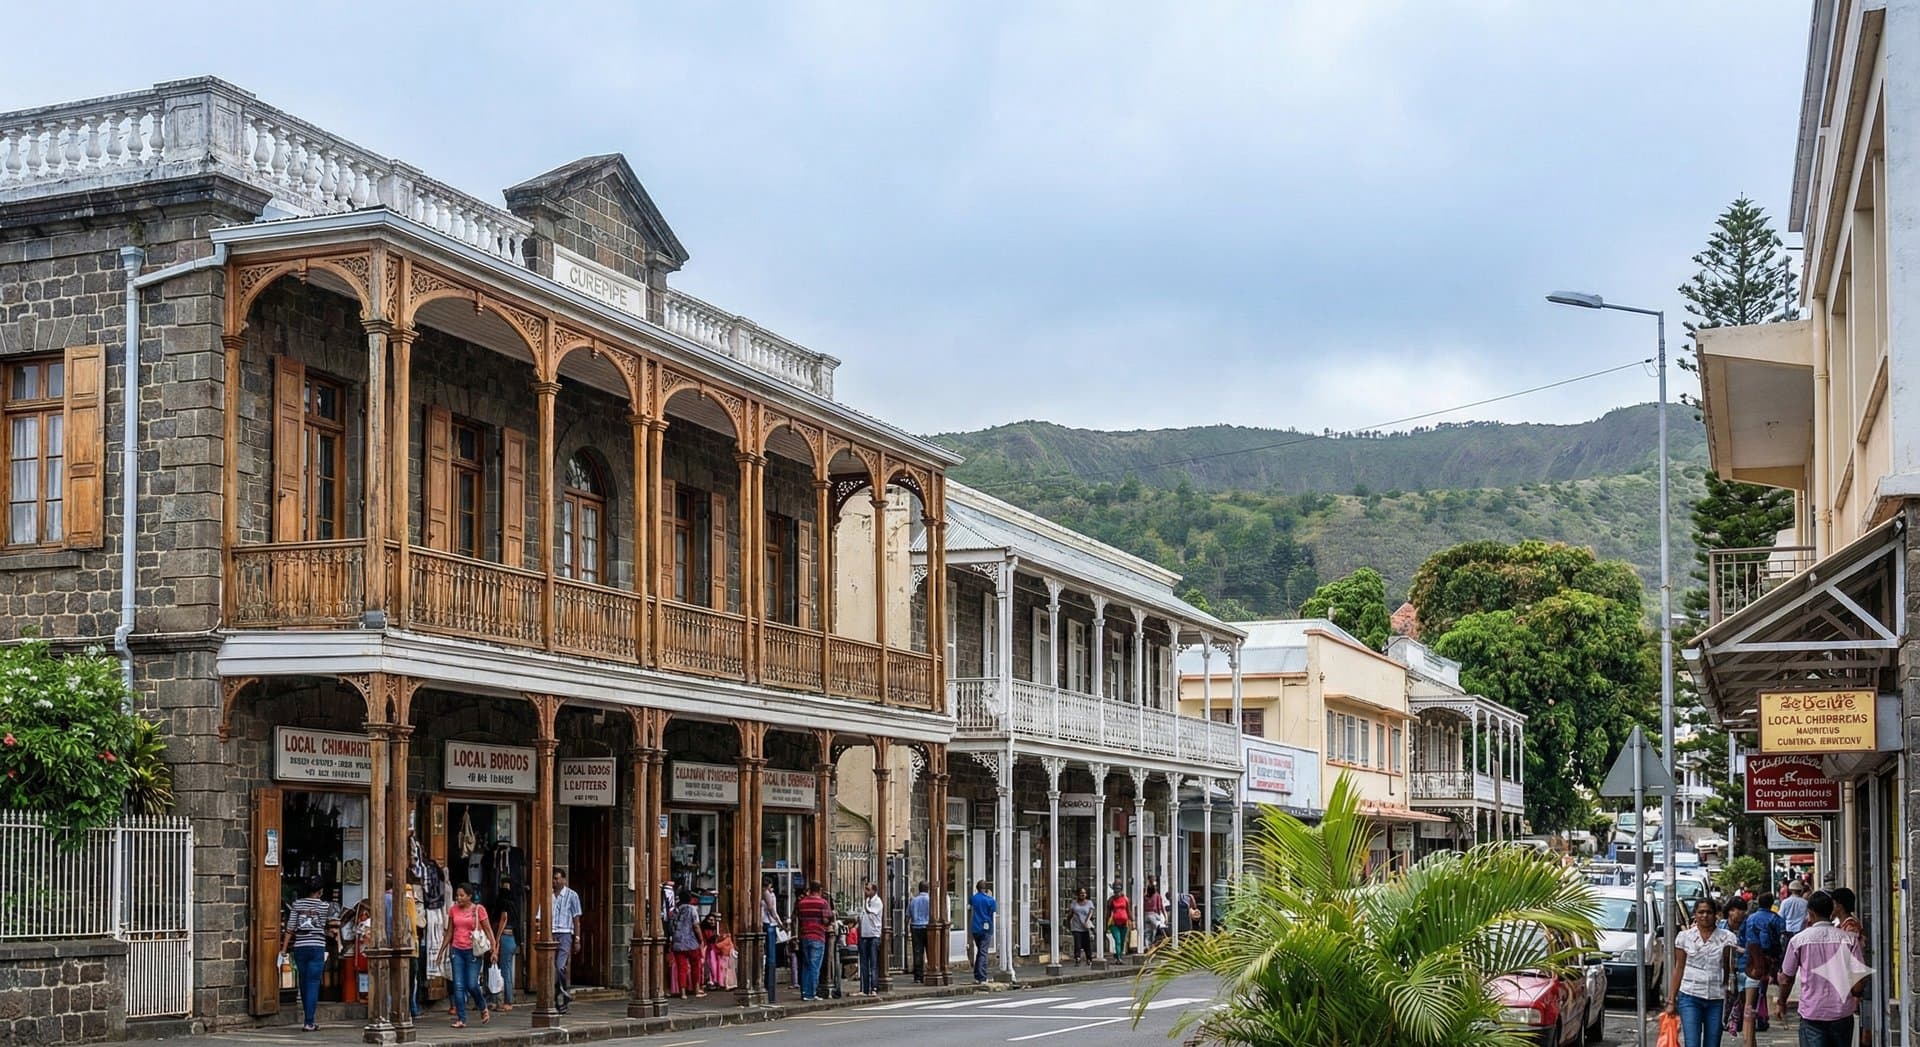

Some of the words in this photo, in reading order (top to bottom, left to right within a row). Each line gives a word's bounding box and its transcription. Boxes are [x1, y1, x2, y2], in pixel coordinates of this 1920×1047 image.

[570, 267, 627, 306] CUREPIPE
[1768, 715, 1802, 725] LOCAL
[285, 735, 316, 753] LOCAL
[453, 749, 487, 769] LOCAL
[563, 764, 586, 775] LOCAL
